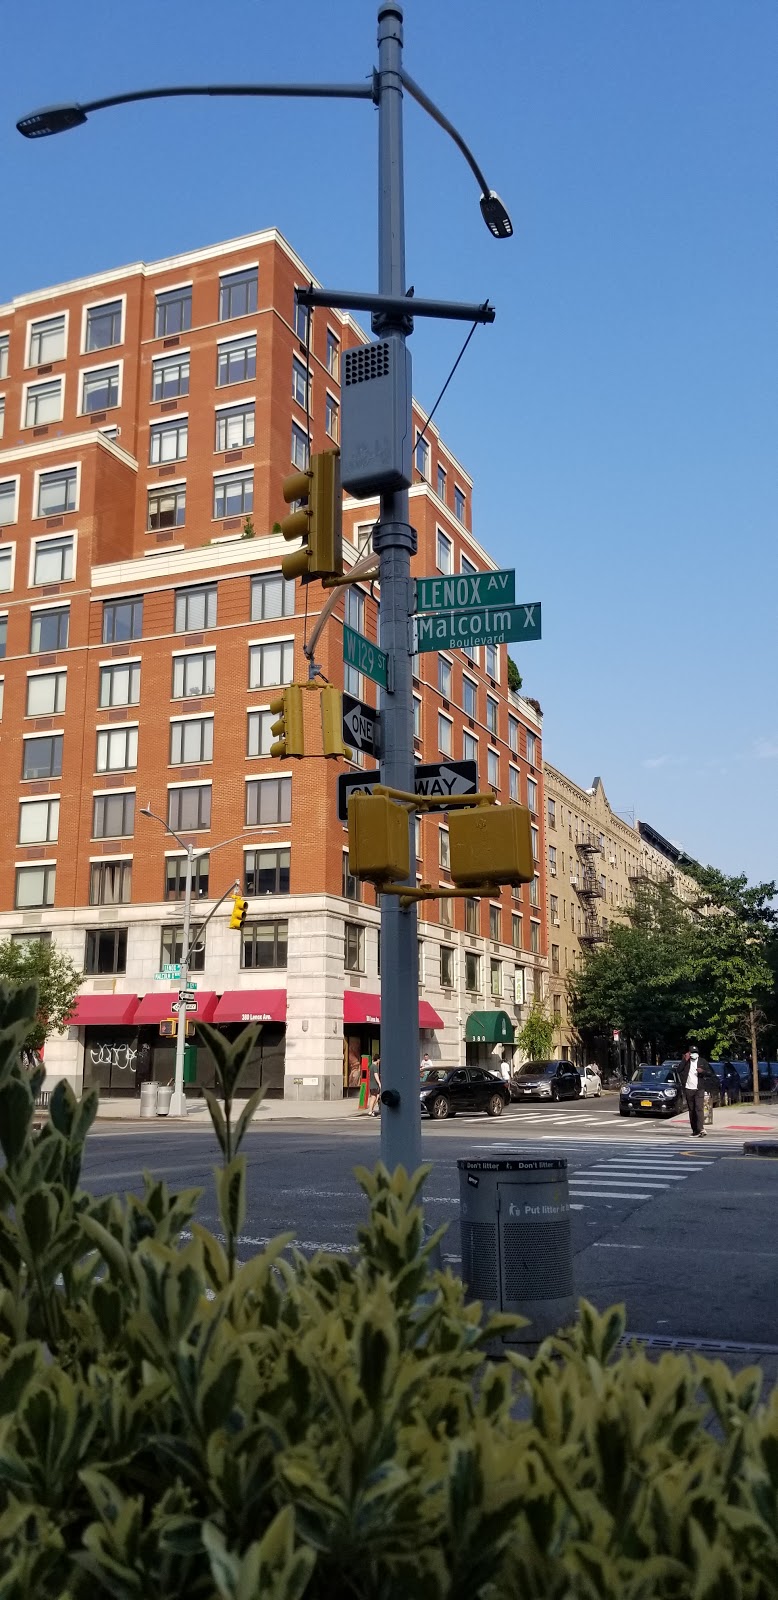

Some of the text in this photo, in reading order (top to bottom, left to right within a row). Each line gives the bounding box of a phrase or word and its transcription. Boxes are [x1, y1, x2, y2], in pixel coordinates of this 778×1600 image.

[421, 574, 509, 608] LENOX AV
[420, 605, 536, 640] Malcolm X
[449, 632, 505, 649] Boulevard
[346, 631, 386, 674] W 129 ST
[352, 714, 373, 741] ONE
[415, 777, 457, 797] WAY
[467, 1161, 499, 1170] Don't litter
[518, 1161, 538, 1169] Don't
[524, 1205, 540, 1214] Put
[542, 1205, 559, 1214] litter
